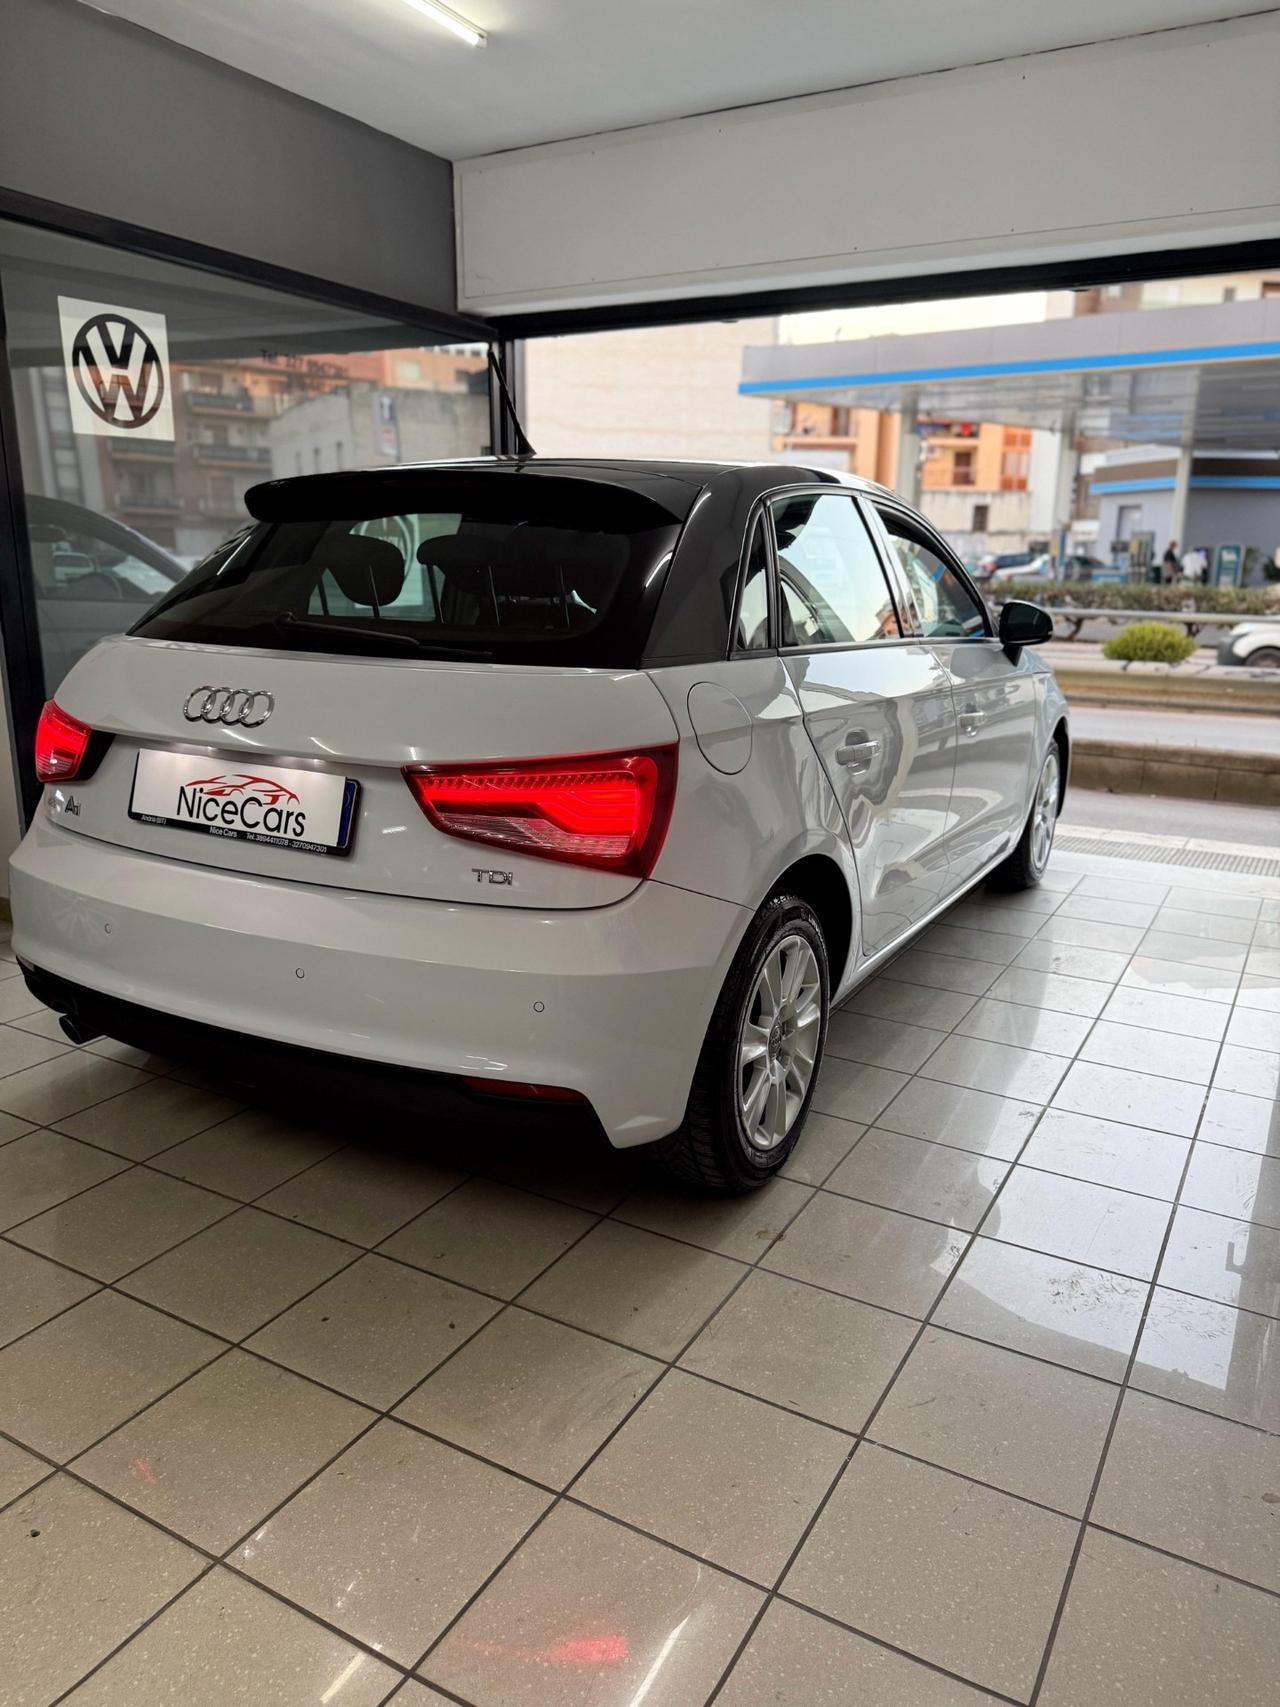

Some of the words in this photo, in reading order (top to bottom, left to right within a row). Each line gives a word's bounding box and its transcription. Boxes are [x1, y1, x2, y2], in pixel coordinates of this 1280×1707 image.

[176, 786, 306, 838] NiceCars
[210, 825, 223, 835] Nice
[223, 828, 238, 838] Cars
[472, 868, 513, 886] TDI
